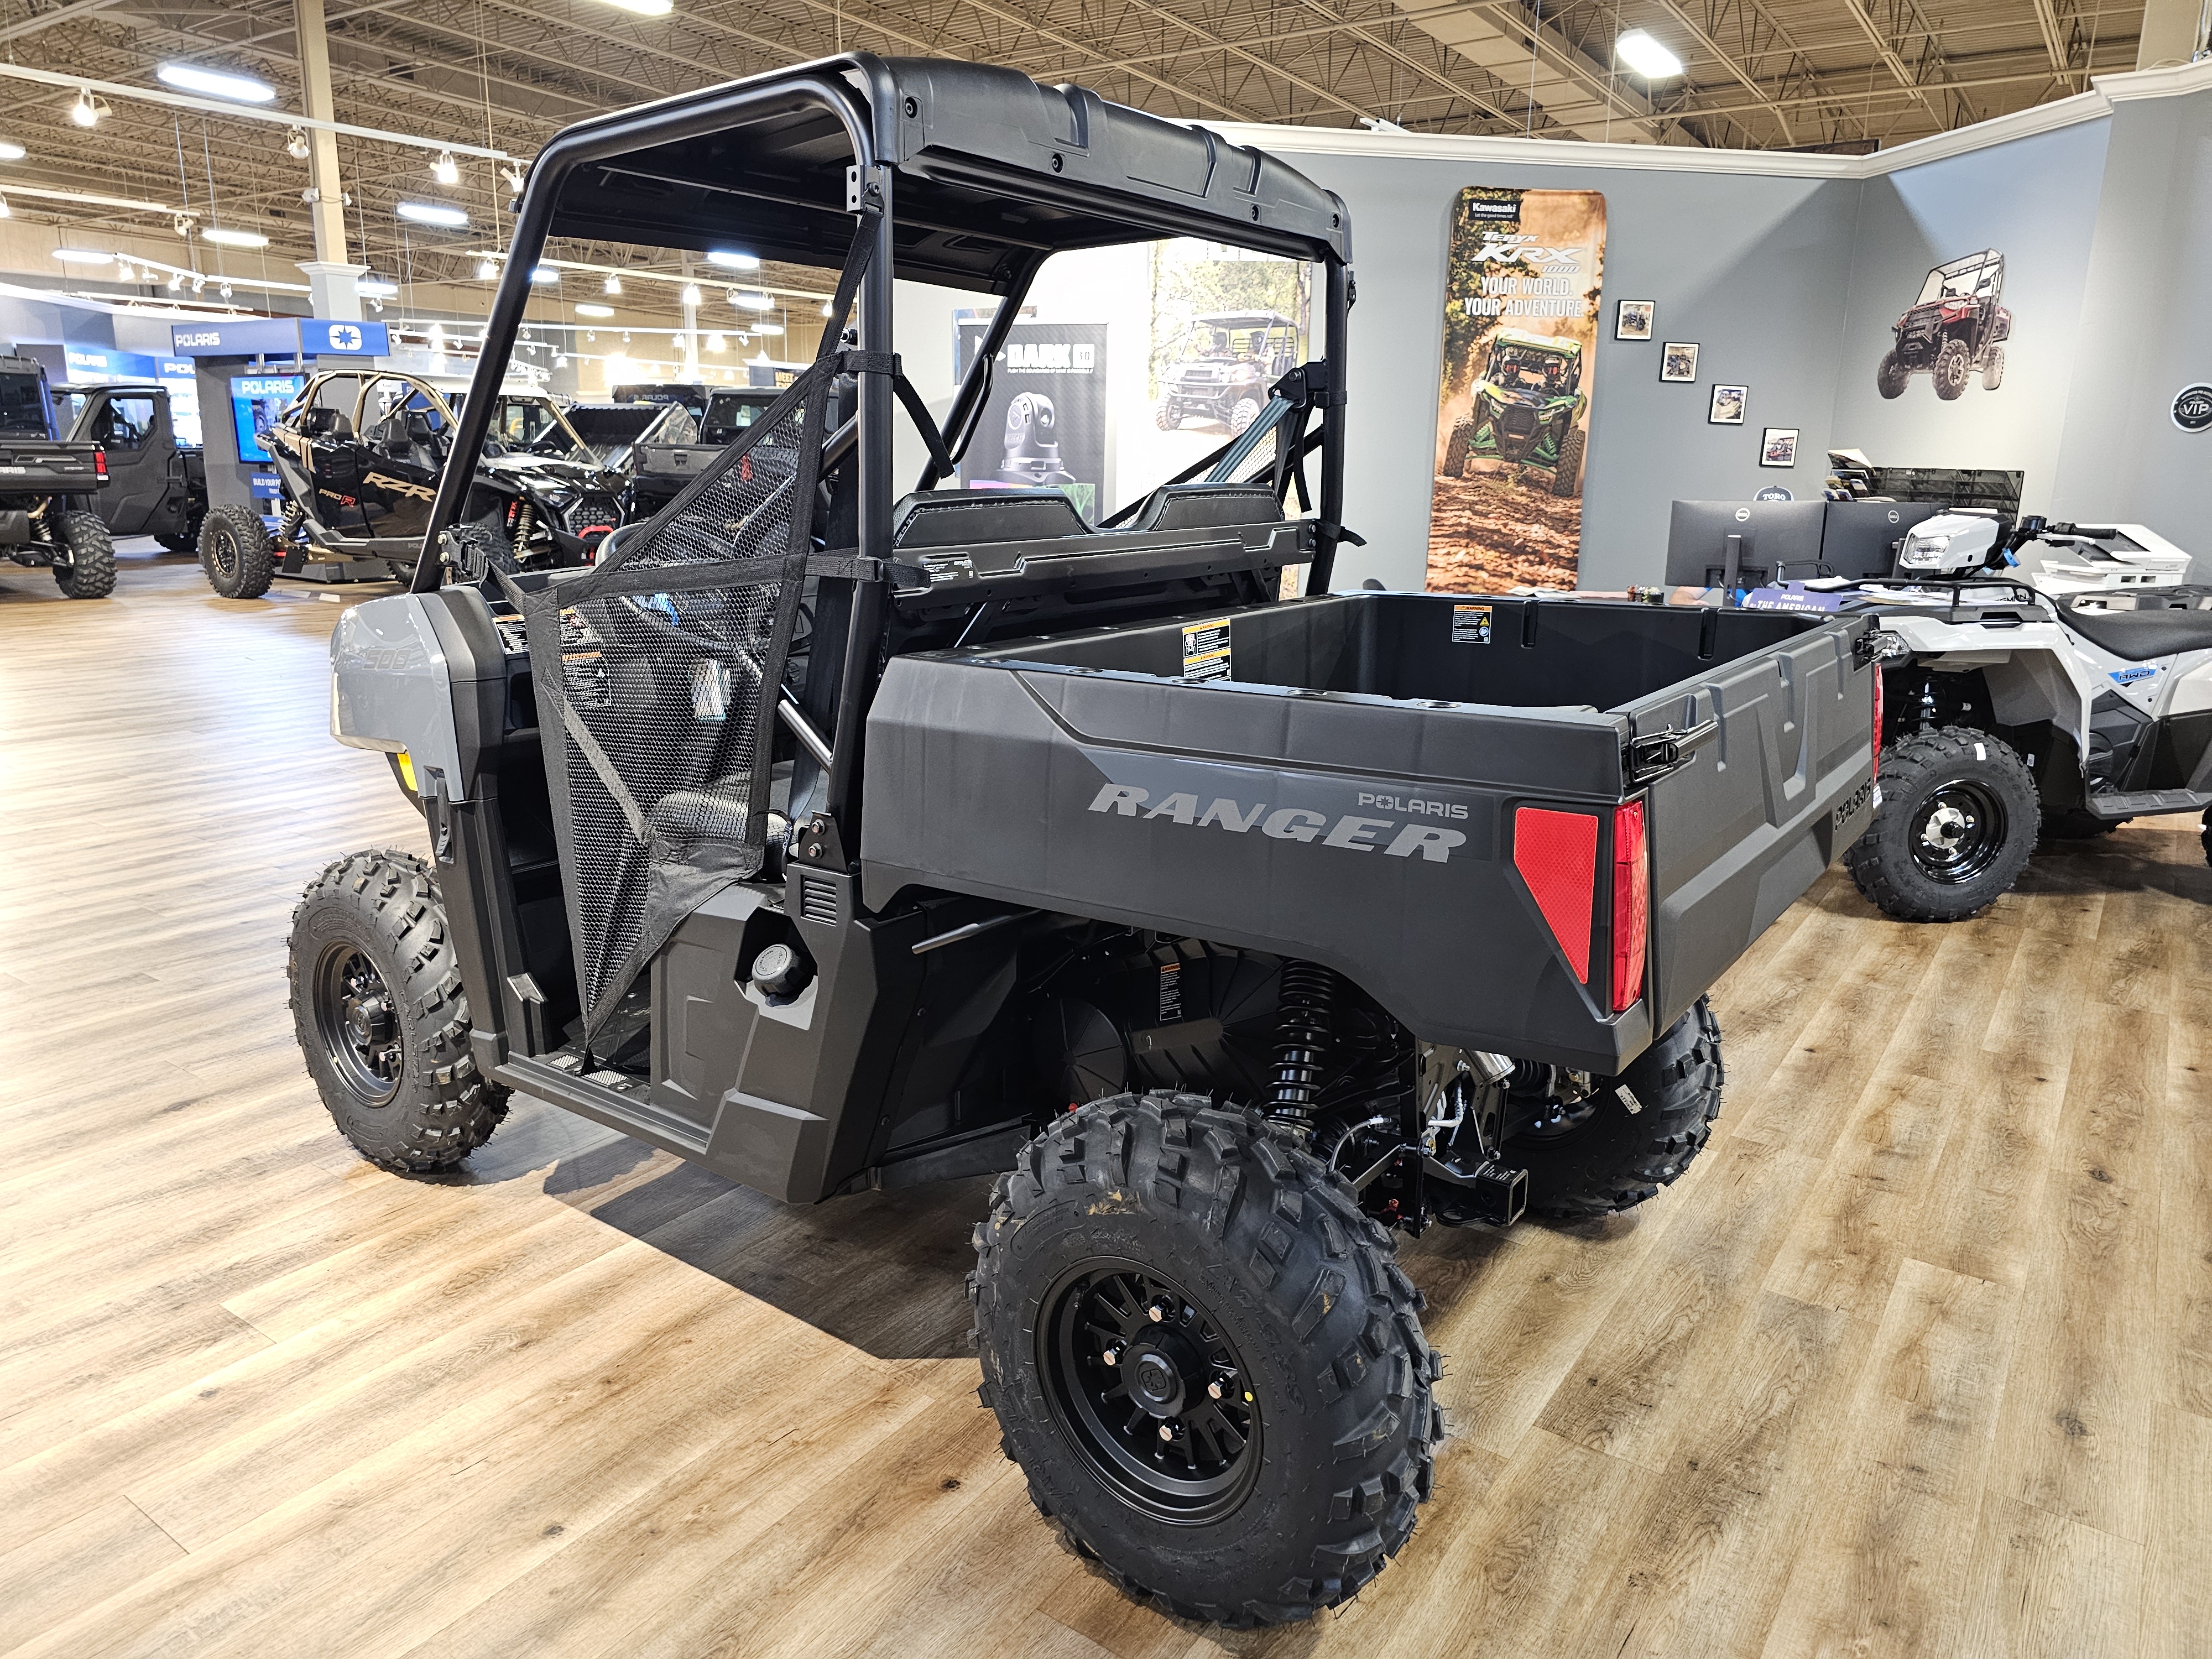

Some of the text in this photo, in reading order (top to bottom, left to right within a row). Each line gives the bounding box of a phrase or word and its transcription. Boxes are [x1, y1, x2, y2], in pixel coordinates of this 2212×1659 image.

[1473, 202, 1516, 212] Kawasaki
[1472, 243, 1584, 264] KRX
[1541, 265, 1580, 273] 1000
[1481, 276, 1573, 296] YOUR WORLD.
[1464, 298, 1584, 317] YOUR ADVENTURE.
[175, 332, 220, 347] POLARIS
[69, 352, 107, 367] POLARIS
[242, 380, 294, 394] POLARIS
[2183, 404, 2209, 415] VIP
[319, 488, 342, 500] PRO
[363, 472, 436, 502] RZR
[1757, 600, 1774, 608] THE
[363, 649, 412, 669] 500
[2119, 670, 2150, 681] AWD
[1358, 792, 1468, 820] POLARIS
[1835, 777, 1871, 831] POLARIS
[1088, 783, 1467, 863] RANGER
